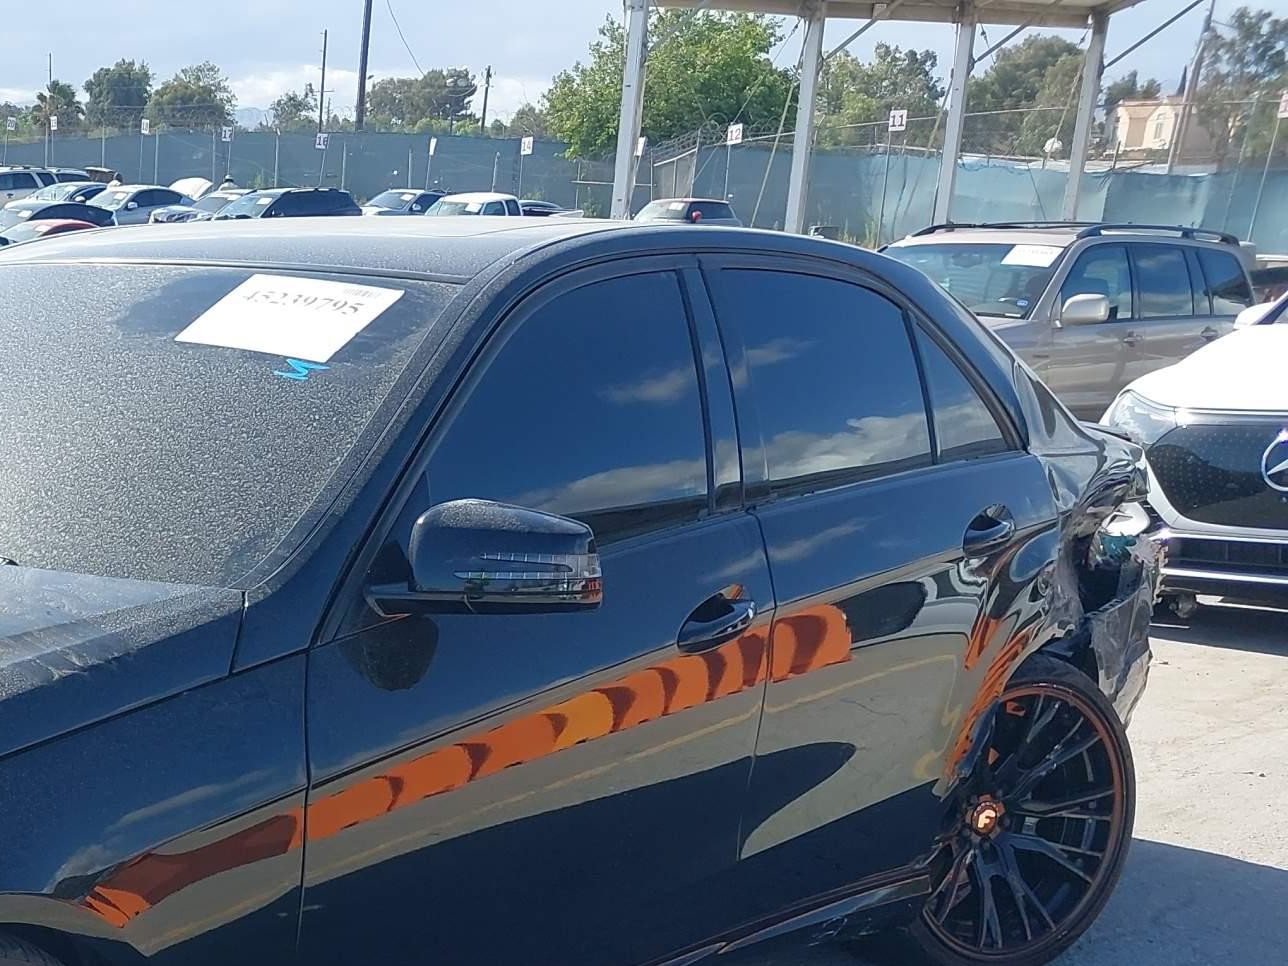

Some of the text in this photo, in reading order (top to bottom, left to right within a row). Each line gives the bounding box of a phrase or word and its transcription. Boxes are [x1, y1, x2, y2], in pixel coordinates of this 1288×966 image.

[7, 119, 16, 129] 20
[890, 114, 905, 128] 11
[222, 129, 233, 140] 17
[728, 128, 742, 142] 12
